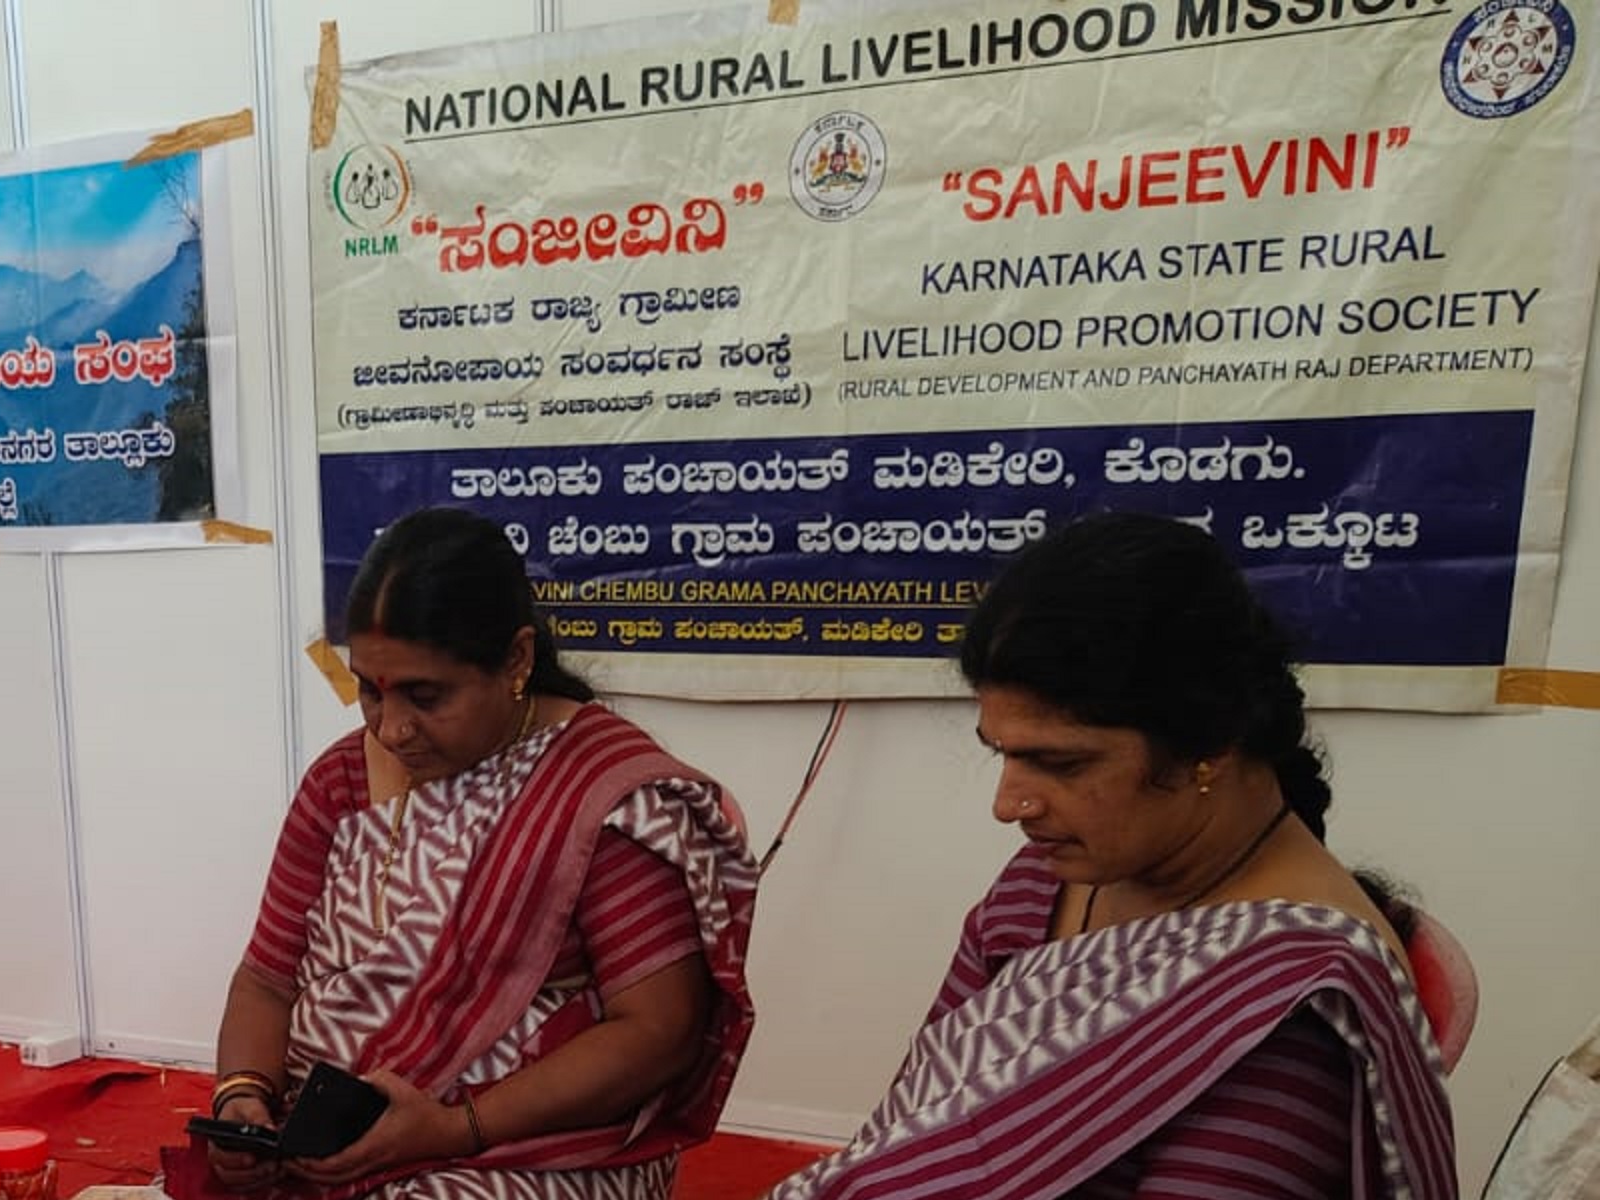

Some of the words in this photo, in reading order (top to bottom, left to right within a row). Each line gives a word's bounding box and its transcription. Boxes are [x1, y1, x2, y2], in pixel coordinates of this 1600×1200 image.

[404, 73, 626, 135] NATIONAL
[641, 49, 805, 108] RURAL
[822, 1, 1157, 85] LIVELIHOOD
[345, 235, 399, 257] NRLM
[920, 248, 1146, 296] KARNATAKA
[1158, 237, 1285, 279] STATE
[1299, 225, 1446, 271] RURAL
[399, 295, 515, 331] ಕರ್ನಾಟಕ
[531, 289, 602, 332] ರಾಜ್ಯ
[619, 284, 741, 328] ಗ್ರಾಮೀಣ
[842, 318, 1062, 363] LIVELIHOOD
[1076, 304, 1323, 350] PROMOTION
[1338, 287, 1543, 335] SOCIETY
[75, 327, 176, 385] ಸಂಘ
[353, 349, 545, 388] ಜೀವನೋಪಾಯ
[560, 340, 703, 378] ಸಂವರ್ಧನ
[837, 373, 912, 402] (RURAL
[917, 366, 1079, 398] DEVELOPMENT
[1085, 363, 1131, 390] AND
[1137, 358, 1288, 387] PANCHAYATH
[1294, 355, 1341, 382] RAJ
[1348, 345, 1533, 379] DEPARTMENT)
[450, 459, 602, 500] ತಾಲೂಕು
[622, 448, 849, 497] ಪಂಚಾಯತ್
[548, 516, 650, 556] ಚೆಂಬು
[671, 516, 775, 569] ಗ್ರಾಮ
[797, 507, 1047, 555] ಪಂಚಾಯತ್
[579, 580, 674, 602] CHEMBU
[680, 580, 768, 602] GRAMA
[771, 581, 933, 604] PANCHAYATH
[607, 615, 664, 643] ಗ್ರಾಮ
